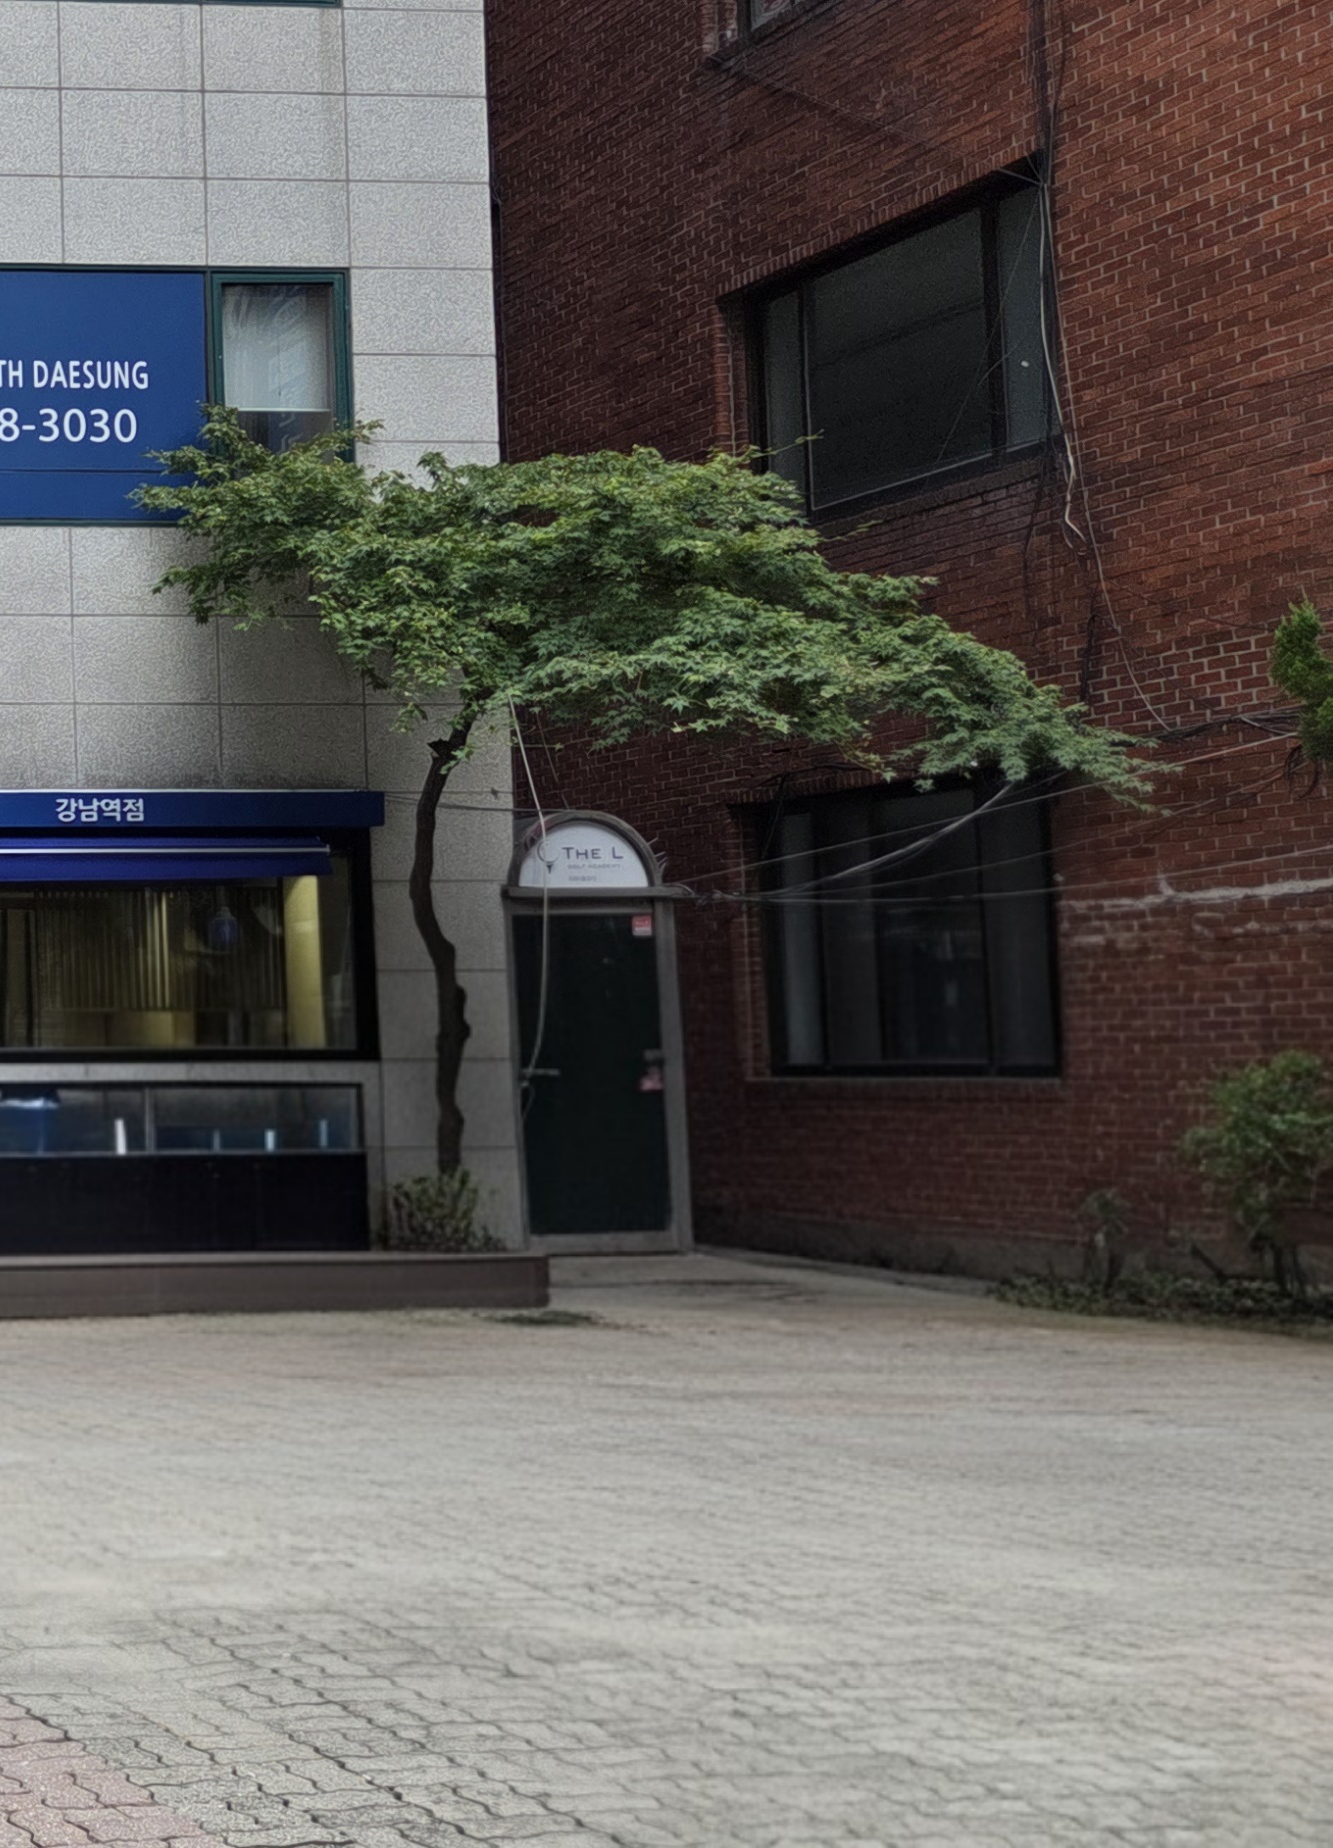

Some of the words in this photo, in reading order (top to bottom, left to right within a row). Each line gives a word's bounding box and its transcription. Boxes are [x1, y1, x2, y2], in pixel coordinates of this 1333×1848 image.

[33, 360, 149, 390] DAESUNG
[55, 798, 144, 823] 강남역점
[561, 846, 601, 859] THE
[611, 846, 624, 859] L
